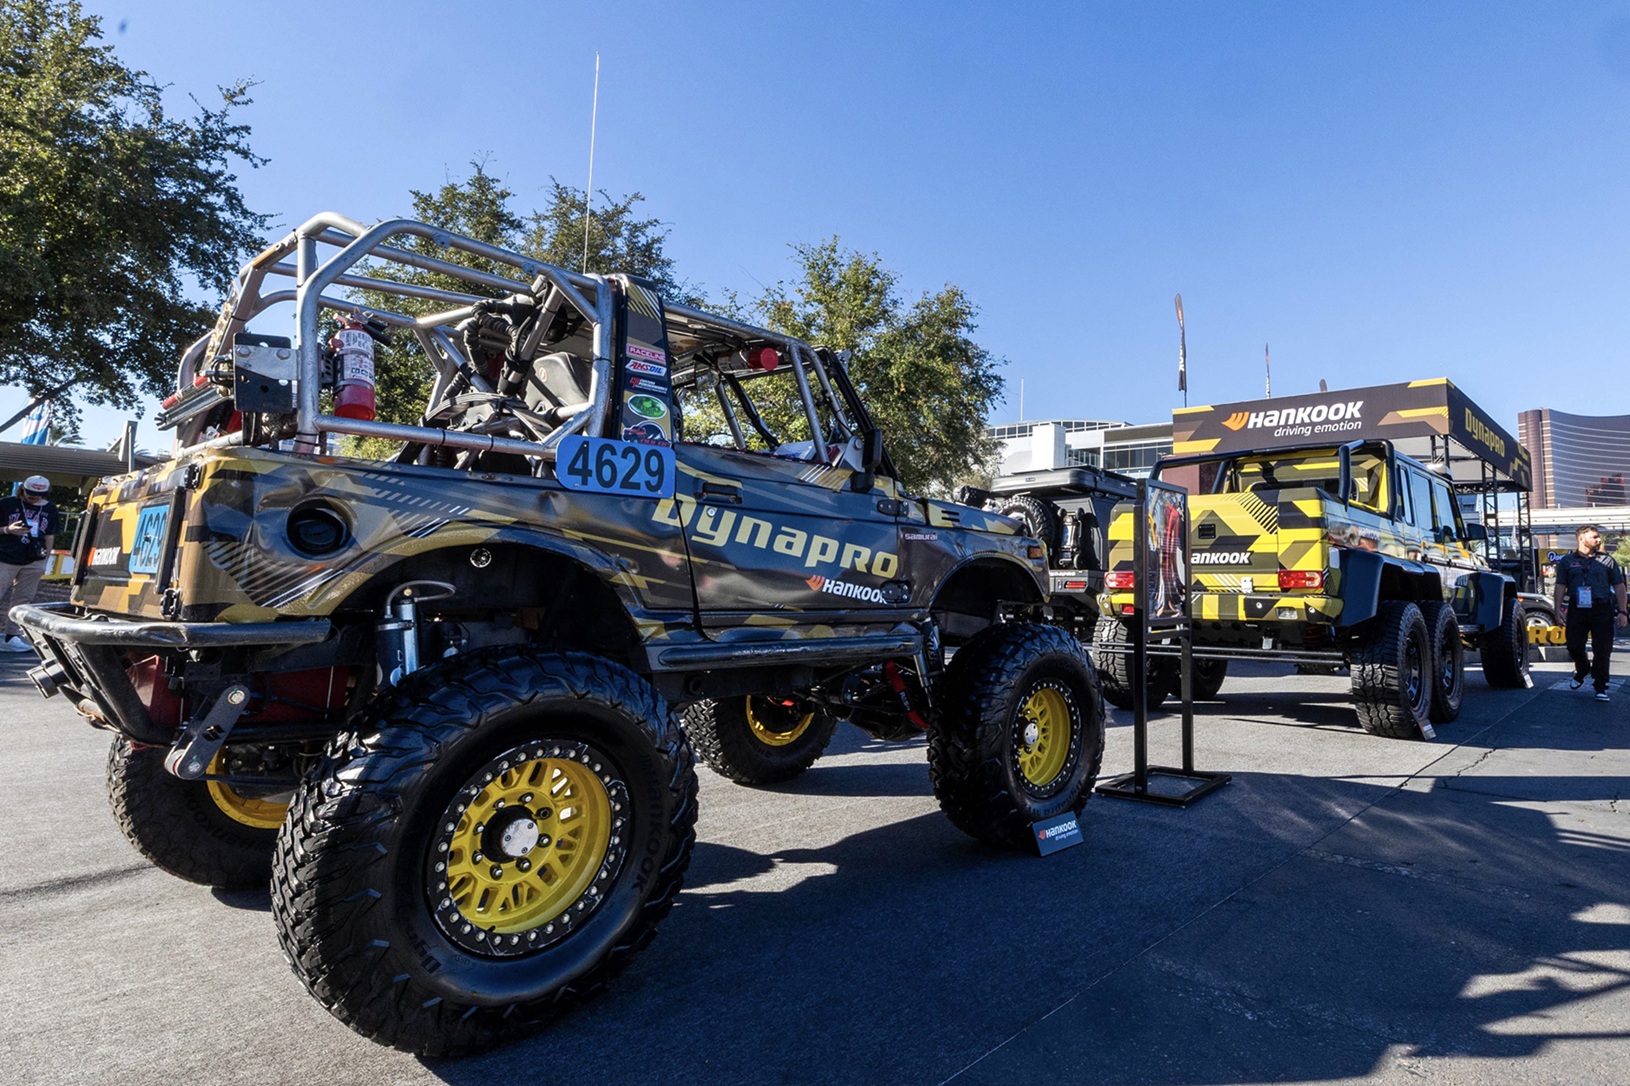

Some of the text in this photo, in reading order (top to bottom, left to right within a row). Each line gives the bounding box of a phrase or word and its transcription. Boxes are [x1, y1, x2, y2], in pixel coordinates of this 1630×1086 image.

[629, 361, 663, 374] AMSOIL
[1274, 420, 1362, 437] driving emotion
[567, 440, 665, 492] 4629
[1190, 551, 1251, 565] anKOOK
